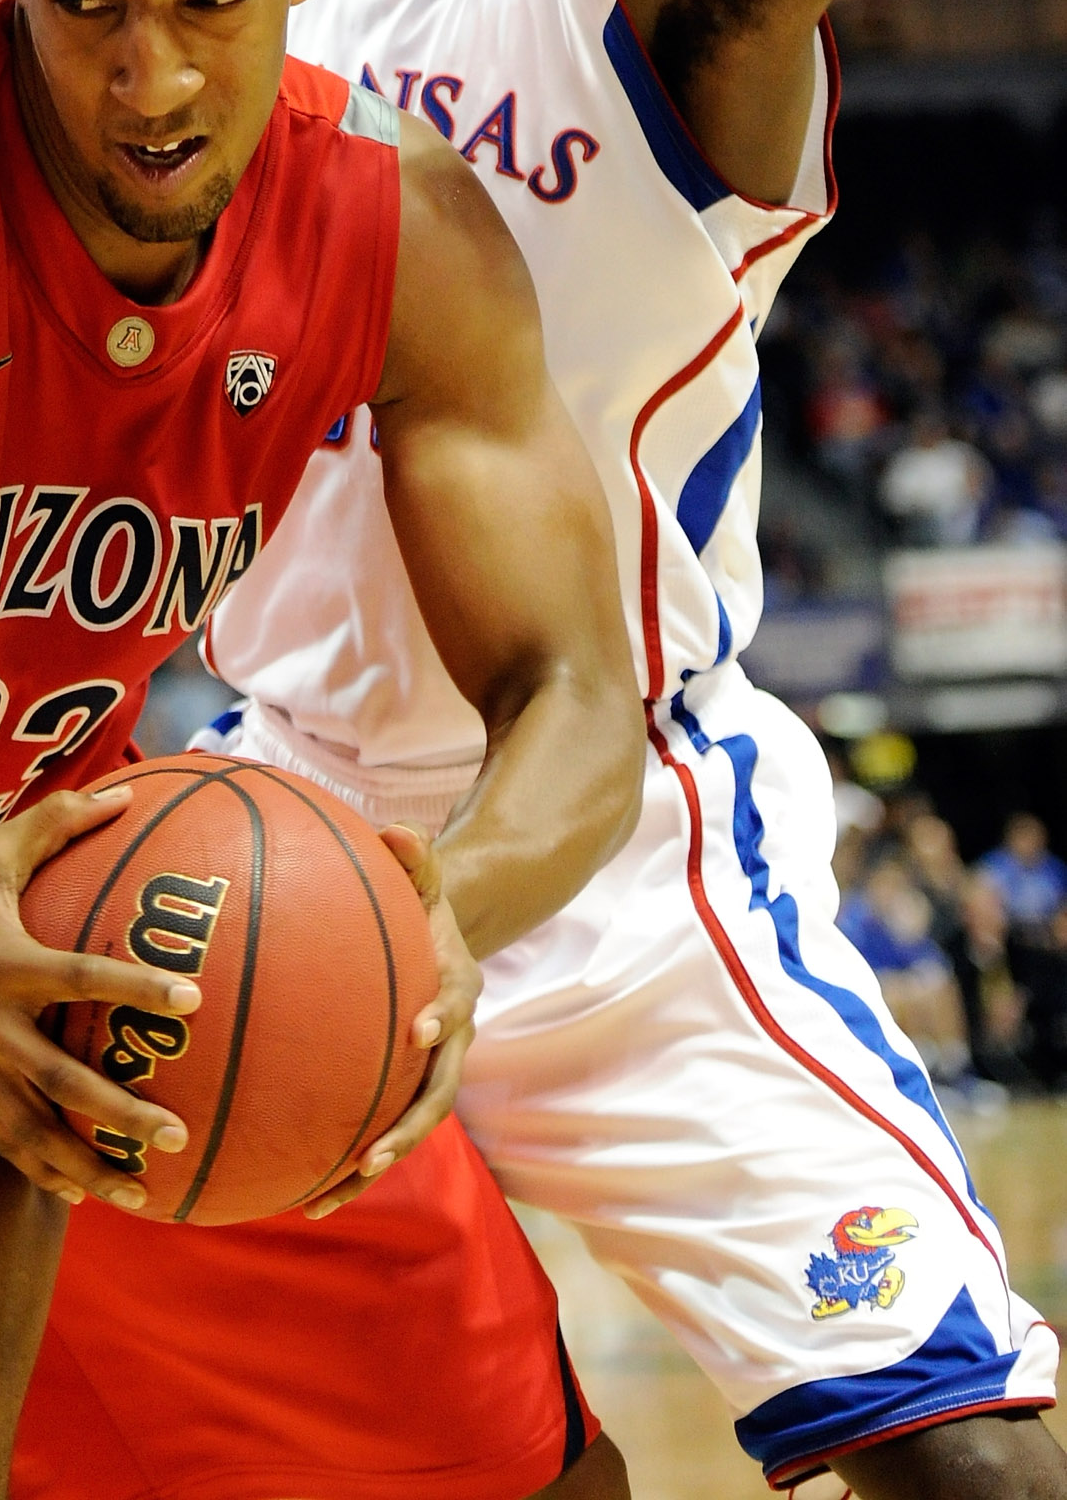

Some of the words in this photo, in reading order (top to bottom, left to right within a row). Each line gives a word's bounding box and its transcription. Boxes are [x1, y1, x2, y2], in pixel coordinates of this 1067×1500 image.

[359, 61, 601, 204] NSAS
[116, 326, 142, 353] A
[226, 355, 275, 394] PAC
[233, 381, 263, 407] 10
[92, 871, 230, 1175] Wlsn
[837, 1260, 870, 1287] KU
